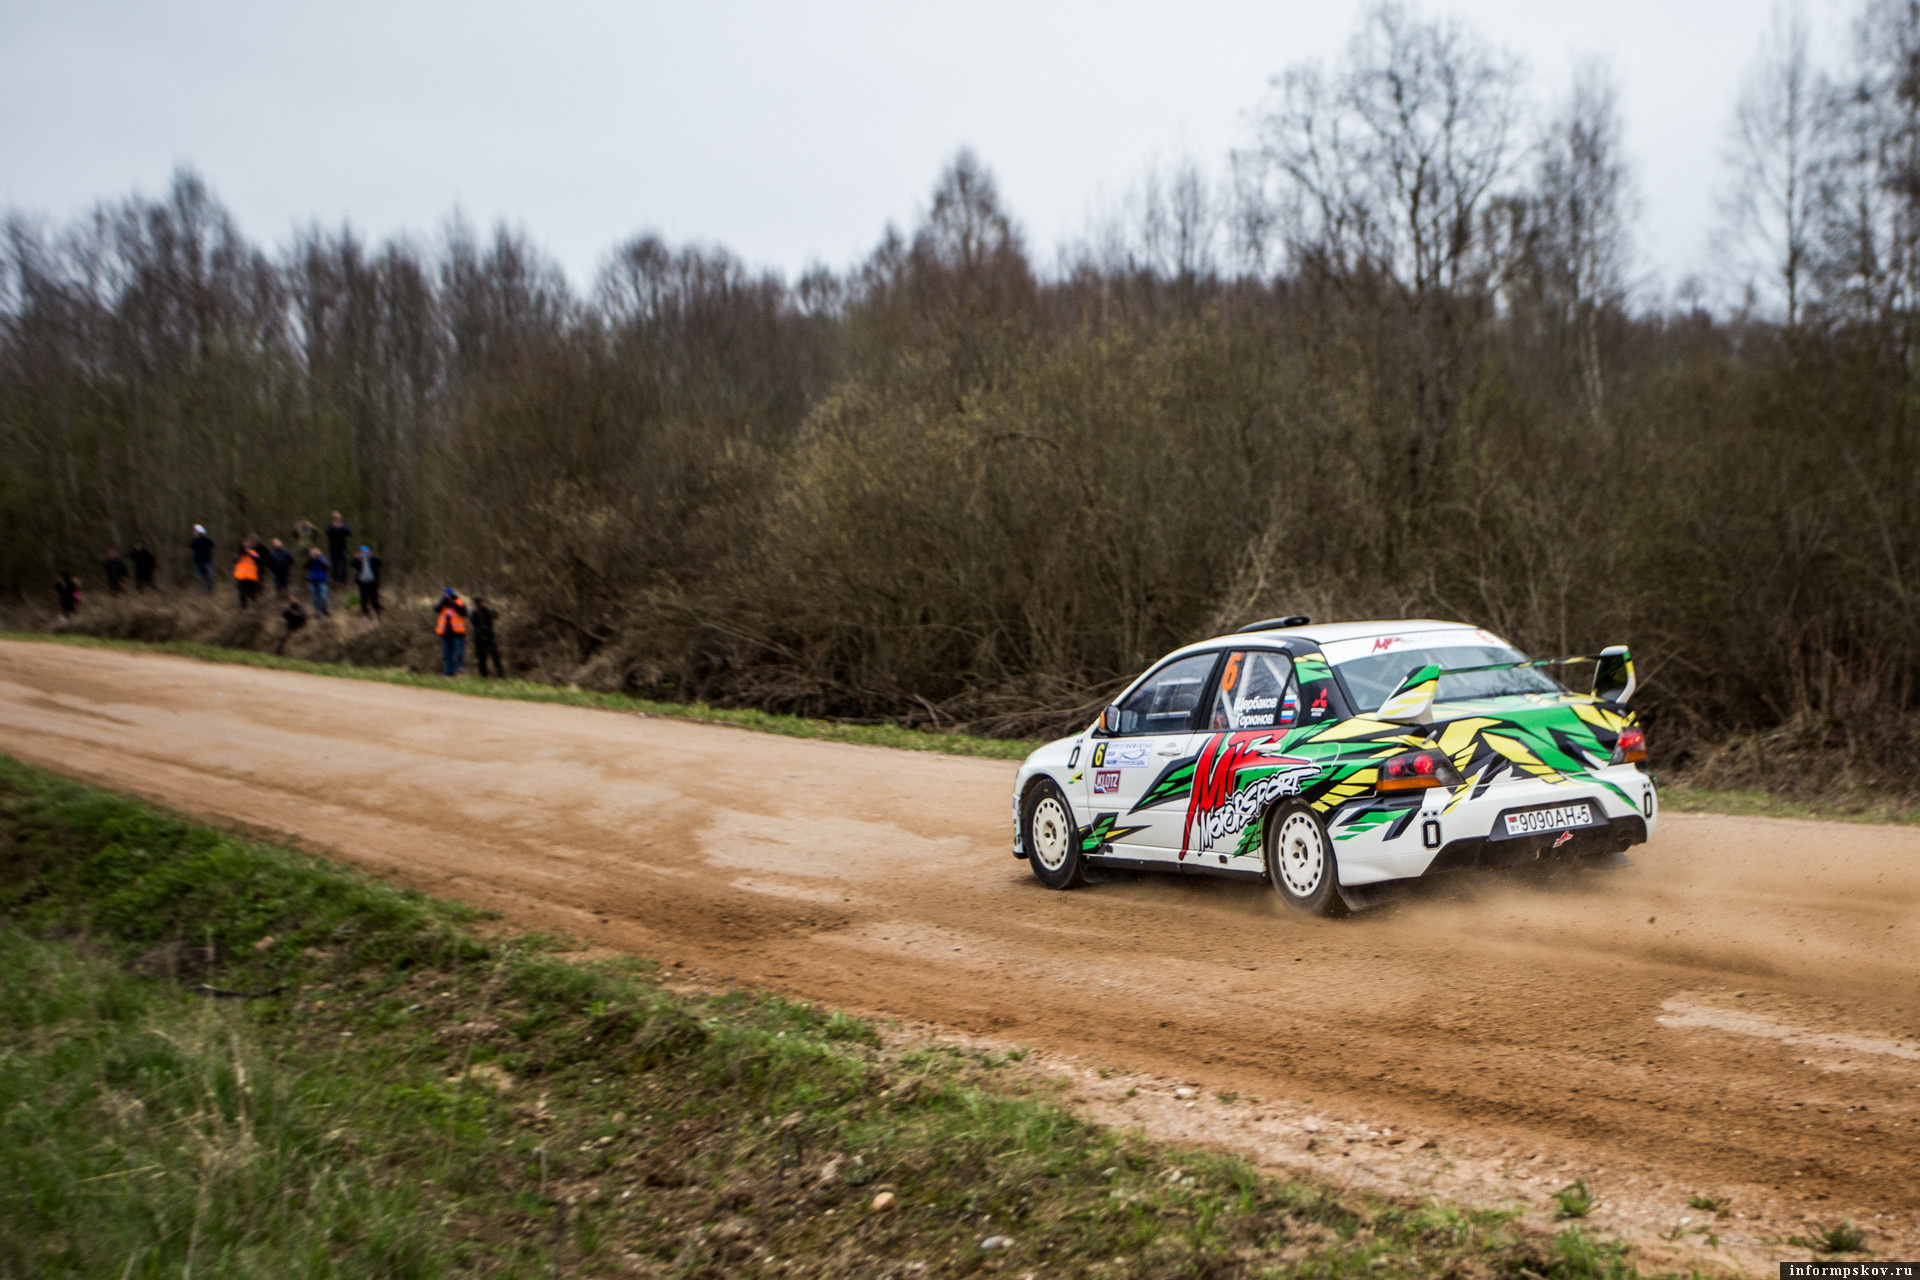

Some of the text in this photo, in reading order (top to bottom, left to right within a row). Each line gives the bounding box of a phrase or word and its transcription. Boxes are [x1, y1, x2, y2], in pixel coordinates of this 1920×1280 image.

[1222, 652, 1243, 691] 6
[1233, 695, 1278, 713] Щербаков
[1235, 713, 1275, 729] Горюнов
[1095, 743, 1106, 766] 6
[1096, 773, 1119, 788] KLOTZ
